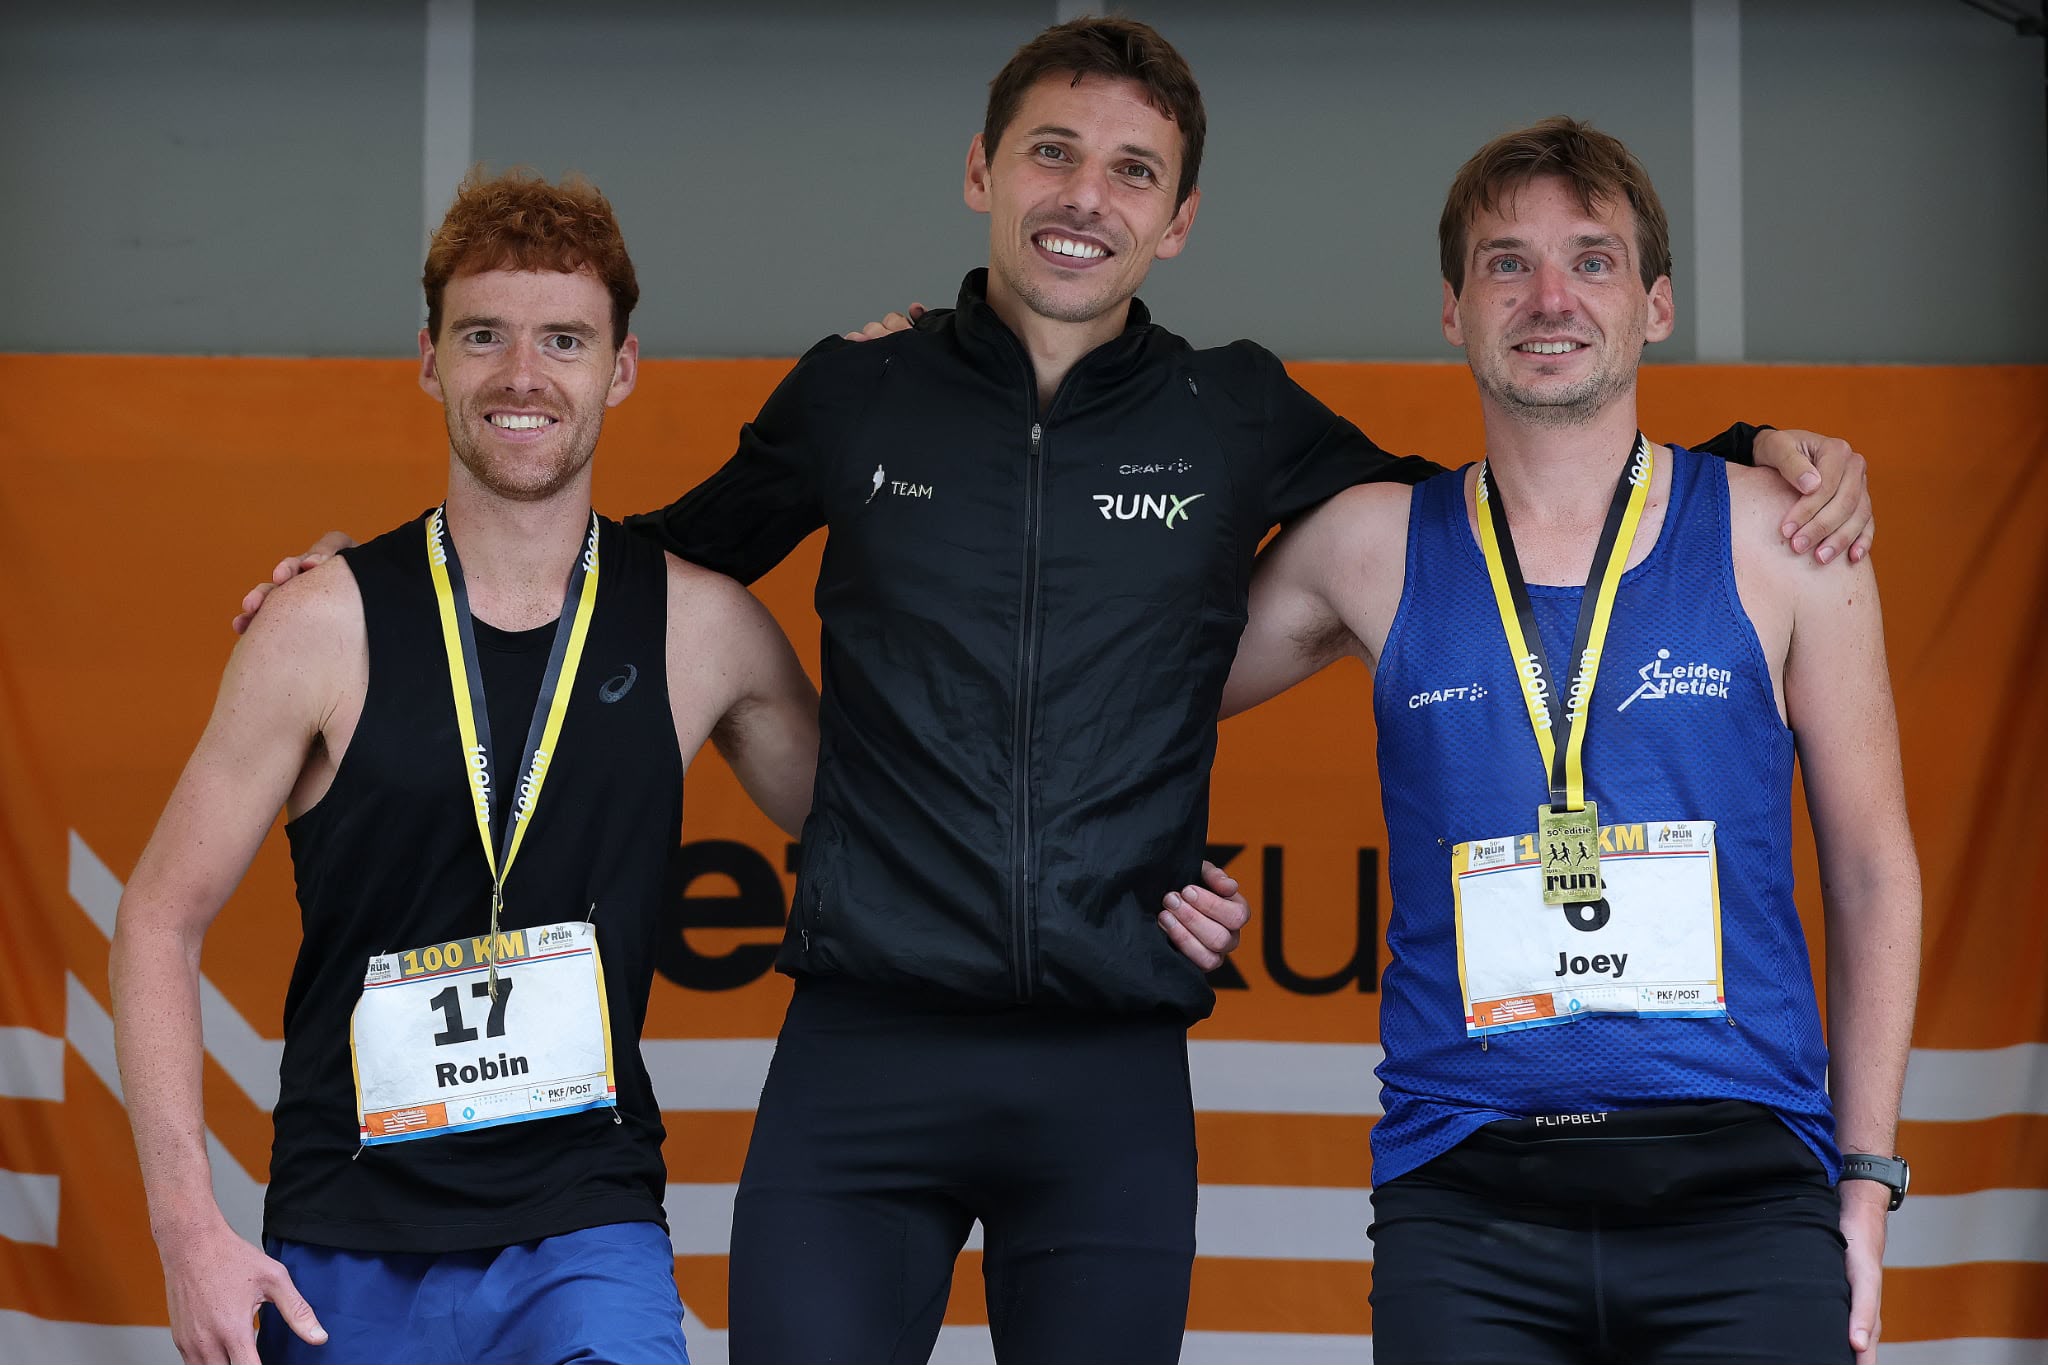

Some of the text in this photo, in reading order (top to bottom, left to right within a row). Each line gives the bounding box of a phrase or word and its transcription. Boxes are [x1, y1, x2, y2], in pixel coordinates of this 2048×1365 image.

[891, 480, 933, 499] TEAM
[1092, 493, 1205, 530] RUNX
[430, 505, 448, 567] 00km
[1653, 659, 1732, 683] Leiden
[1519, 653, 1553, 730] 100km
[1566, 648, 1597, 722] 100km
[1408, 687, 1468, 709] CRAFT
[468, 743, 492, 824] 100km
[514, 748, 547, 822] 100km
[1564, 826, 1591, 835] editie
[1599, 825, 1645, 852] KM
[1672, 829, 1693, 839] RUN
[1484, 845, 1505, 855] RUN
[1546, 873, 1597, 891] run
[551, 930, 572, 941] RUN
[403, 931, 526, 976] 100 KM
[1555, 952, 1629, 979] Joey
[370, 962, 390, 972] RUN
[1656, 989, 1700, 1001] PKF/POST
[430, 977, 514, 1047] 17
[435, 1052, 529, 1088] Robin
[548, 1083, 592, 1099] PKF/POST
[1535, 1112, 1608, 1127] FLIPBELT
